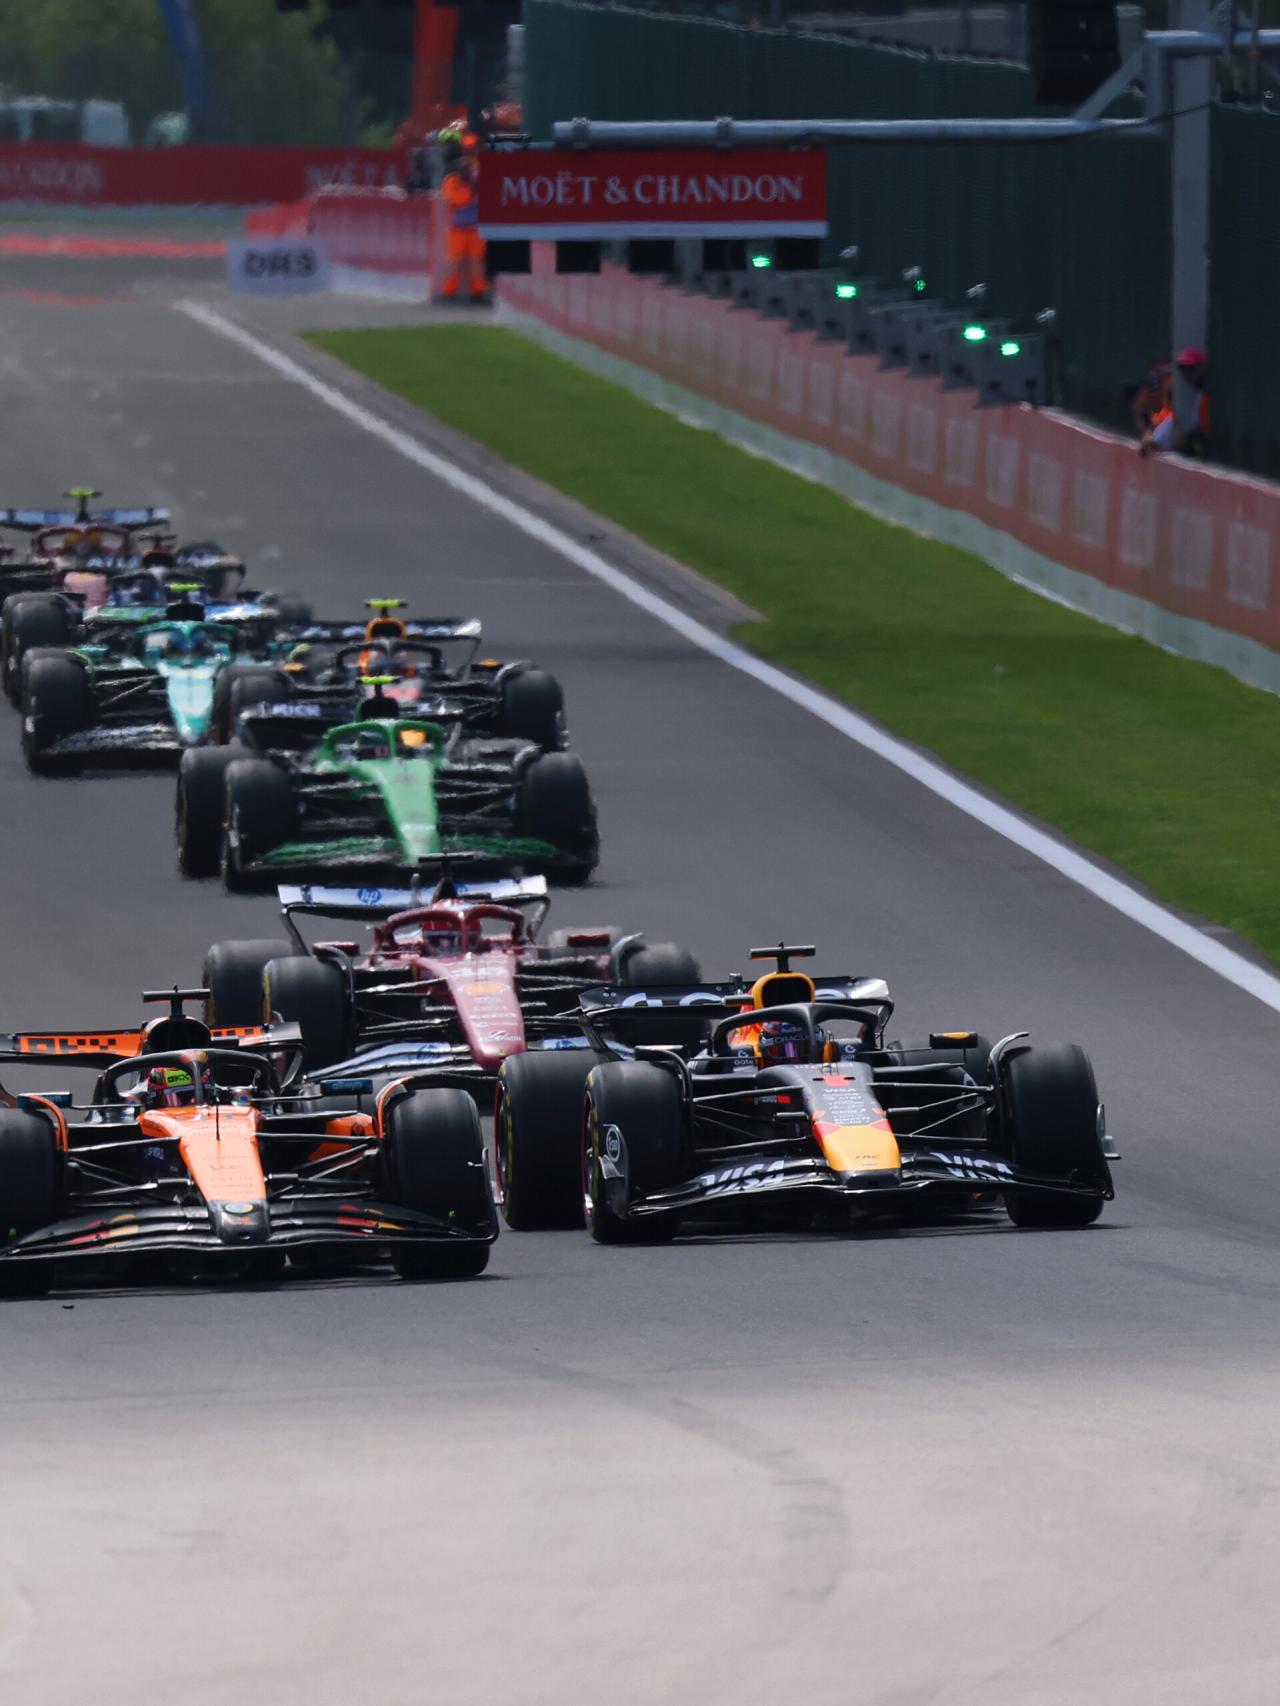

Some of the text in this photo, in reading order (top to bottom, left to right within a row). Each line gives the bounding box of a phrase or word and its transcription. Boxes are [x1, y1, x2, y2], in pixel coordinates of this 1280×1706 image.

[501, 171, 804, 207] MOËT & CHANDON
[167, 1073, 190, 1083] OKX
[700, 1160, 785, 1196] VISA
[929, 1152, 1019, 1184] VISA
